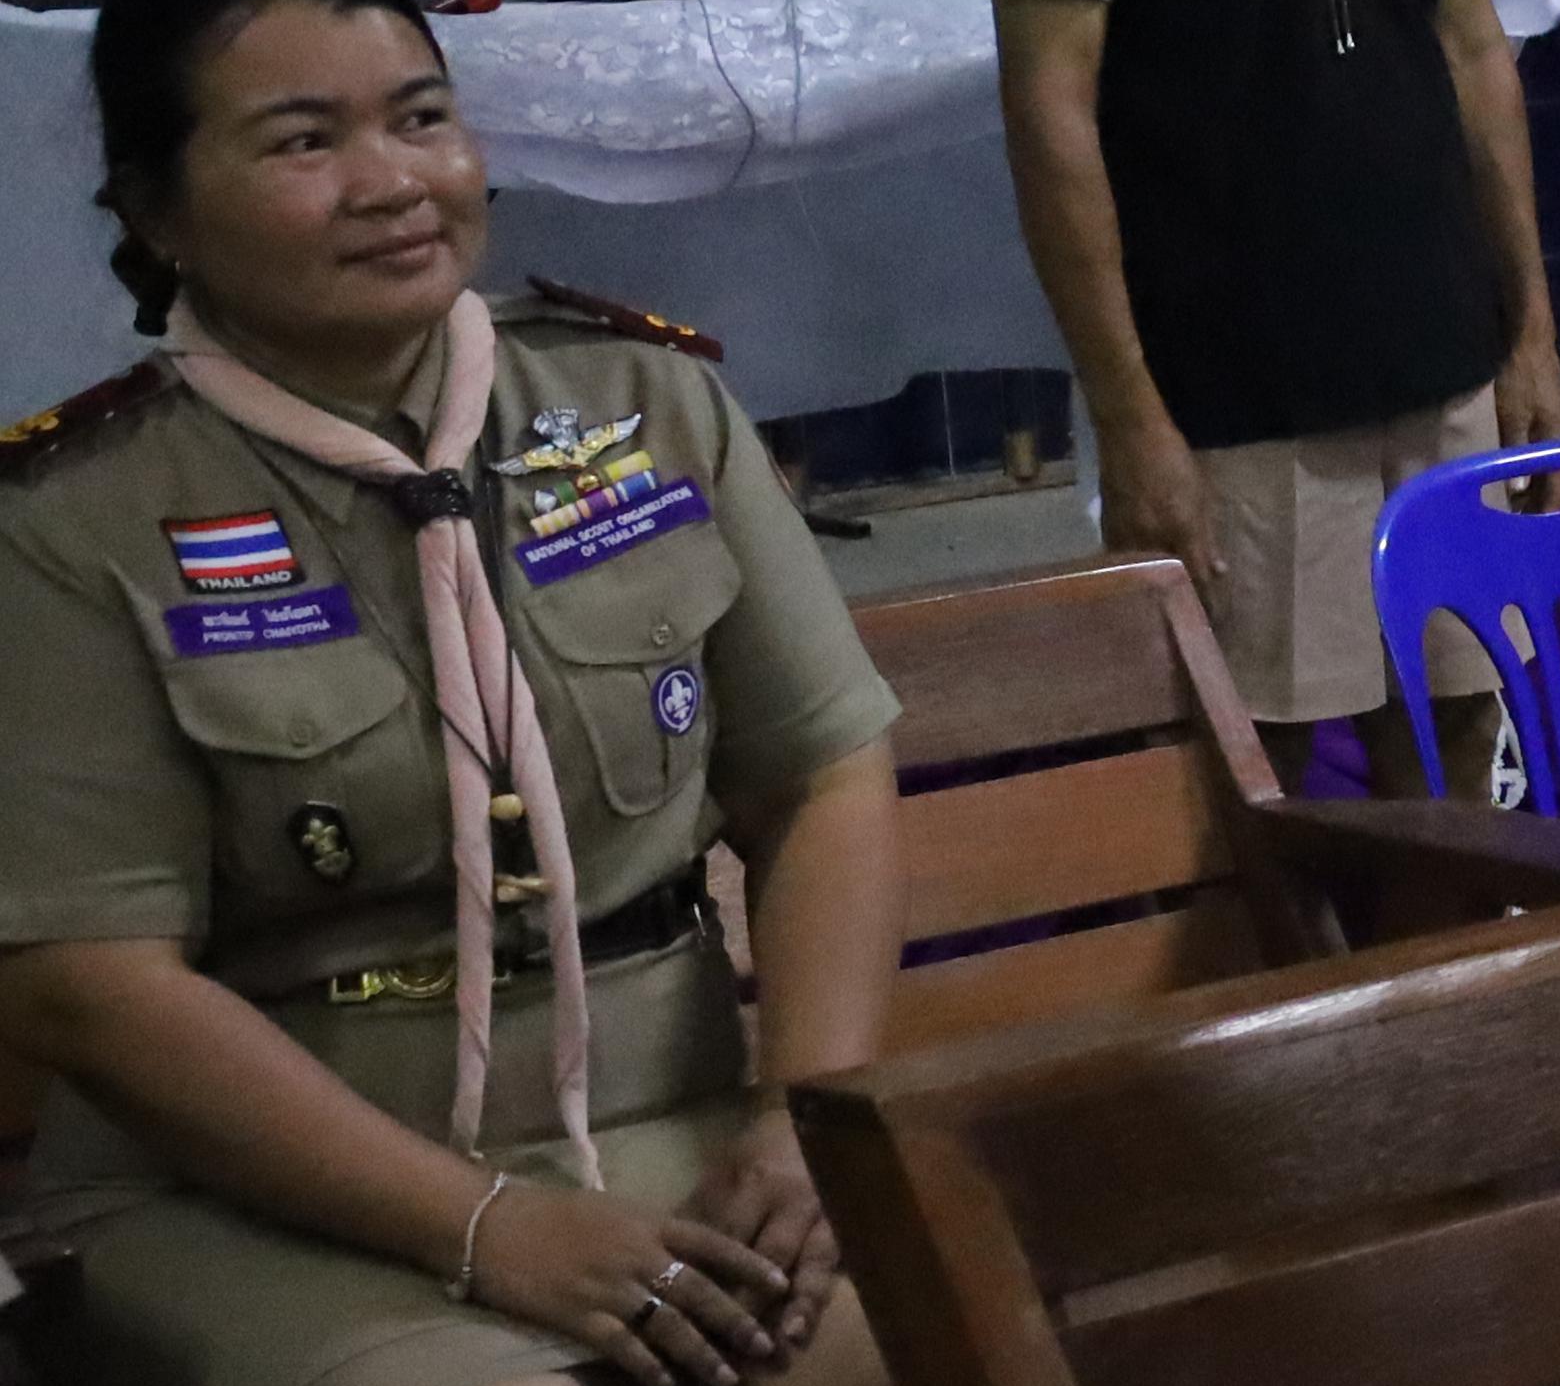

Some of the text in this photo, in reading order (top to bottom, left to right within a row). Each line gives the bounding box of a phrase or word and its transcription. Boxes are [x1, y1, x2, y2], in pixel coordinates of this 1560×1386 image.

[525, 485, 694, 564] NATIONAL SCOUT ORGANIZATION
[579, 517, 656, 558] OF THAILAND
[196, 569, 293, 591] THAILAND
